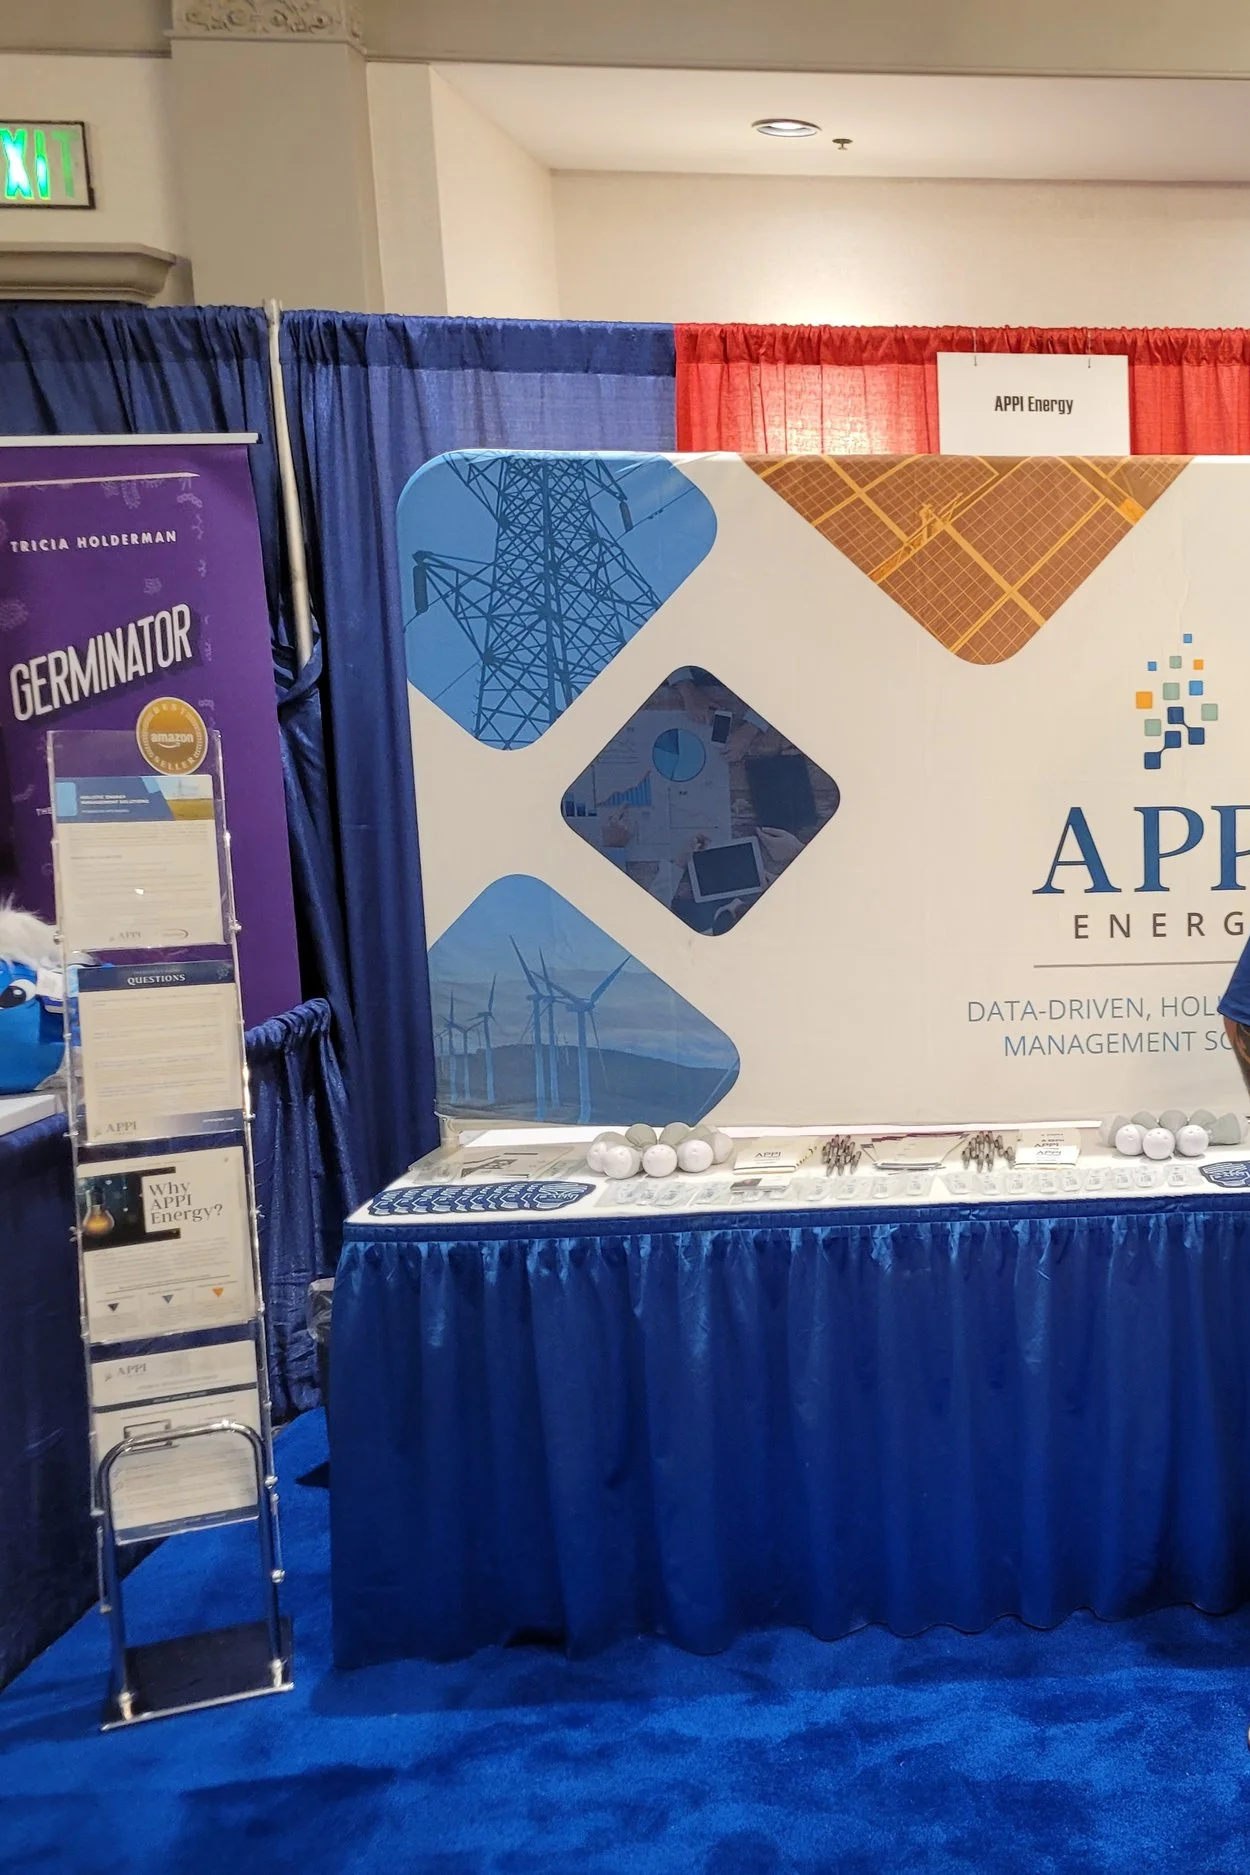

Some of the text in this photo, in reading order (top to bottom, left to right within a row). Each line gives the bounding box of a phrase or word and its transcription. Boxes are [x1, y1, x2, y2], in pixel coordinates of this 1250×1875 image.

[0, 128, 81, 200] XIT
[994, 395, 1074, 415] APPI Energy
[10, 530, 177, 553] TRICIA HOLDERMAN
[9, 603, 193, 722] GERMINATOR
[151, 732, 194, 744] amazon
[154, 756, 196, 771] SELLER
[1074, 911, 1246, 939] ENERG
[127, 973, 186, 986] QUESTIONS
[967, 998, 1151, 1023] DATA-DRIVEN,
[1004, 1030, 1197, 1057] MANAGEMENT
[106, 1121, 137, 1133] APPI
[149, 1181, 191, 1198] Why
[150, 1194, 192, 1211] APPI
[151, 1203, 223, 1225] Energy?
